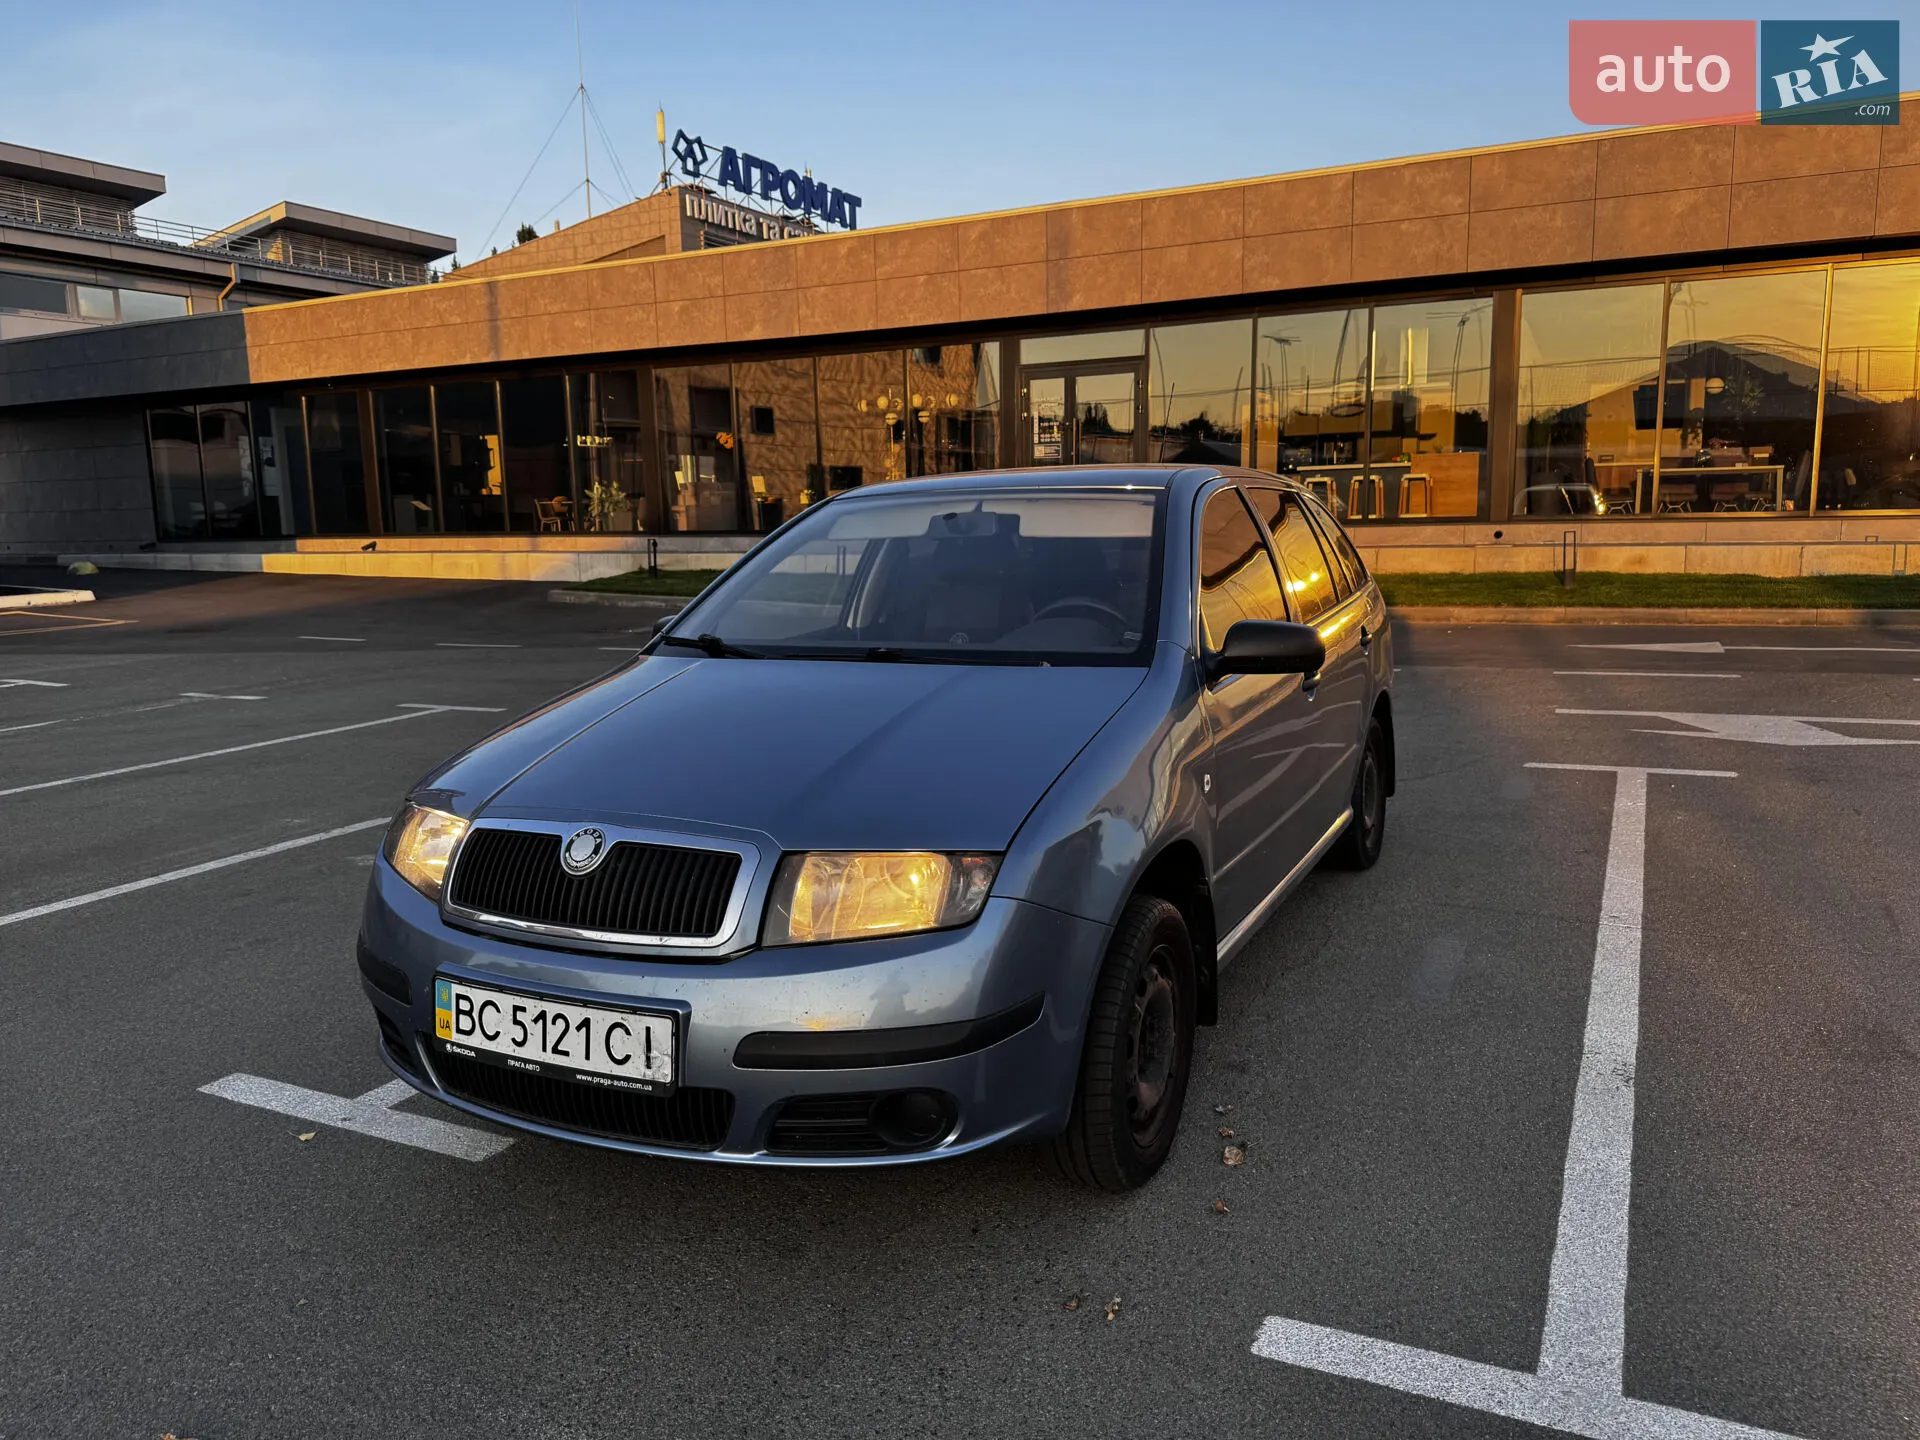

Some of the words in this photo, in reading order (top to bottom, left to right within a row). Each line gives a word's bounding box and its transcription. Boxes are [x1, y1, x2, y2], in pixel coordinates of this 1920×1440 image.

[718, 146, 861, 230] АГРОМАТ
[760, 218, 780, 241] та
[439, 1018, 451, 1032] UA
[455, 993, 501, 1042] BC
[511, 1004, 591, 1061] 5121
[605, 1022, 652, 1070] CI
[507, 1059, 525, 1069] ПРАГА
[525, 1063, 540, 1072] АВТО
[575, 1073, 653, 1091] www.praga-auto.com.ua
